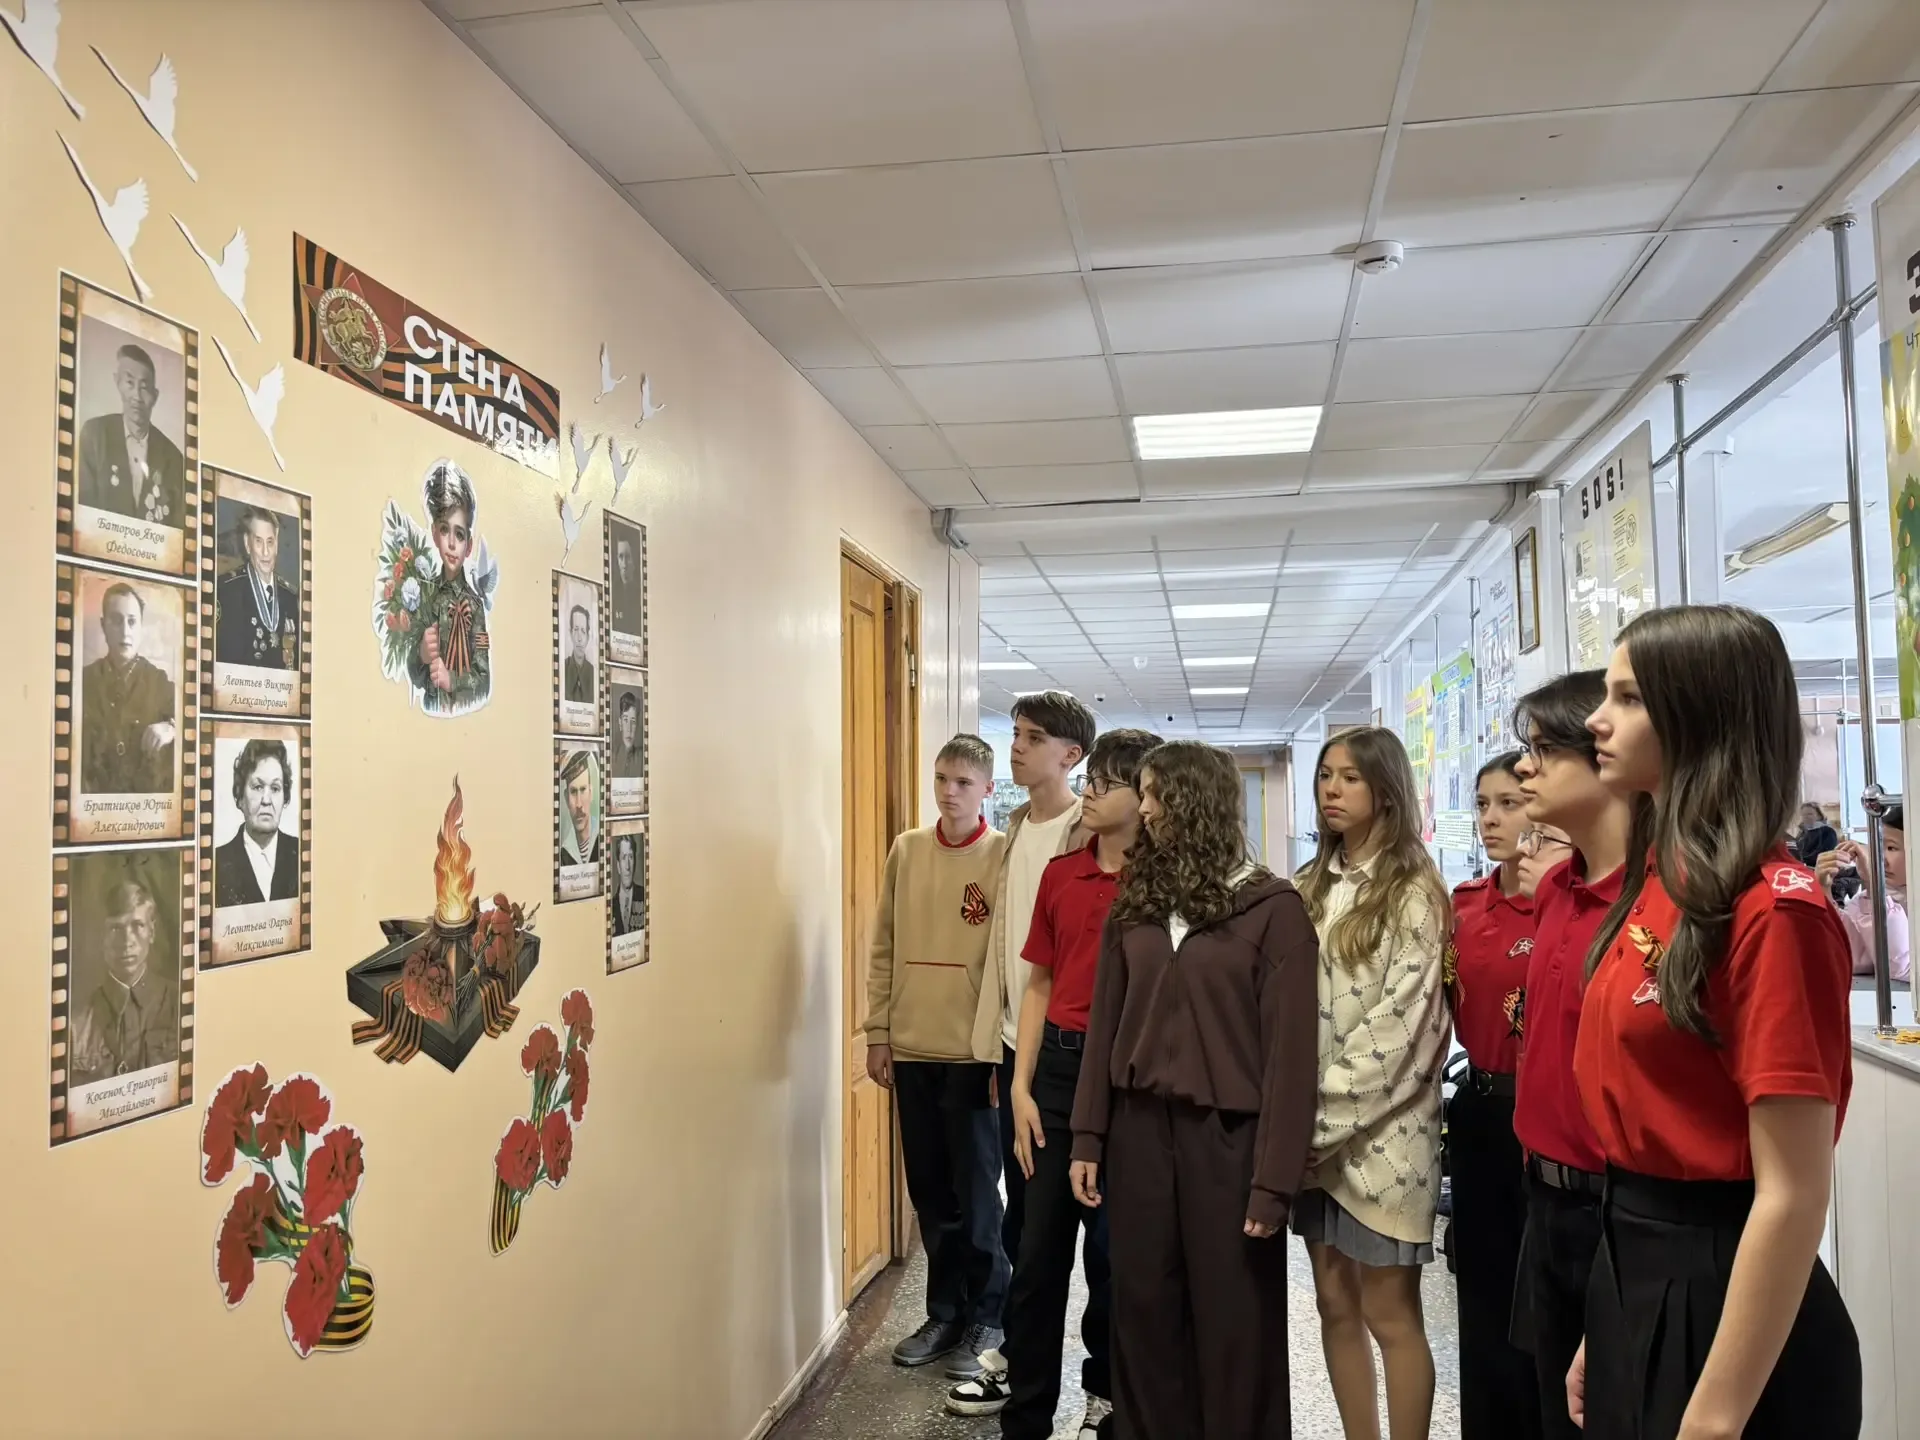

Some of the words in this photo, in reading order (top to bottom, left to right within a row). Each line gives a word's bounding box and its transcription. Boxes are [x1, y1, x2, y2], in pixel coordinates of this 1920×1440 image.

[404, 315, 527, 413] СТЕНА
[97, 517, 141, 538] Баторов
[139, 527, 165, 544] Яков
[106, 540, 158, 561] Федосович
[223, 674, 262, 687] Леонтьев
[264, 679, 293, 694] Виктор
[229, 693, 288, 710] Александрович
[84, 800, 141, 815] Братников
[142, 798, 173, 814] Юрий
[90, 818, 166, 835] Александрович
[222, 921, 267, 938] Леонтьева
[268, 917, 293, 931] Дарья
[234, 937, 284, 953] Максимовна
[85, 1085, 127, 1105] Косенок
[125, 1072, 168, 1096] Григорий
[99, 1096, 156, 1121] Михайлович
